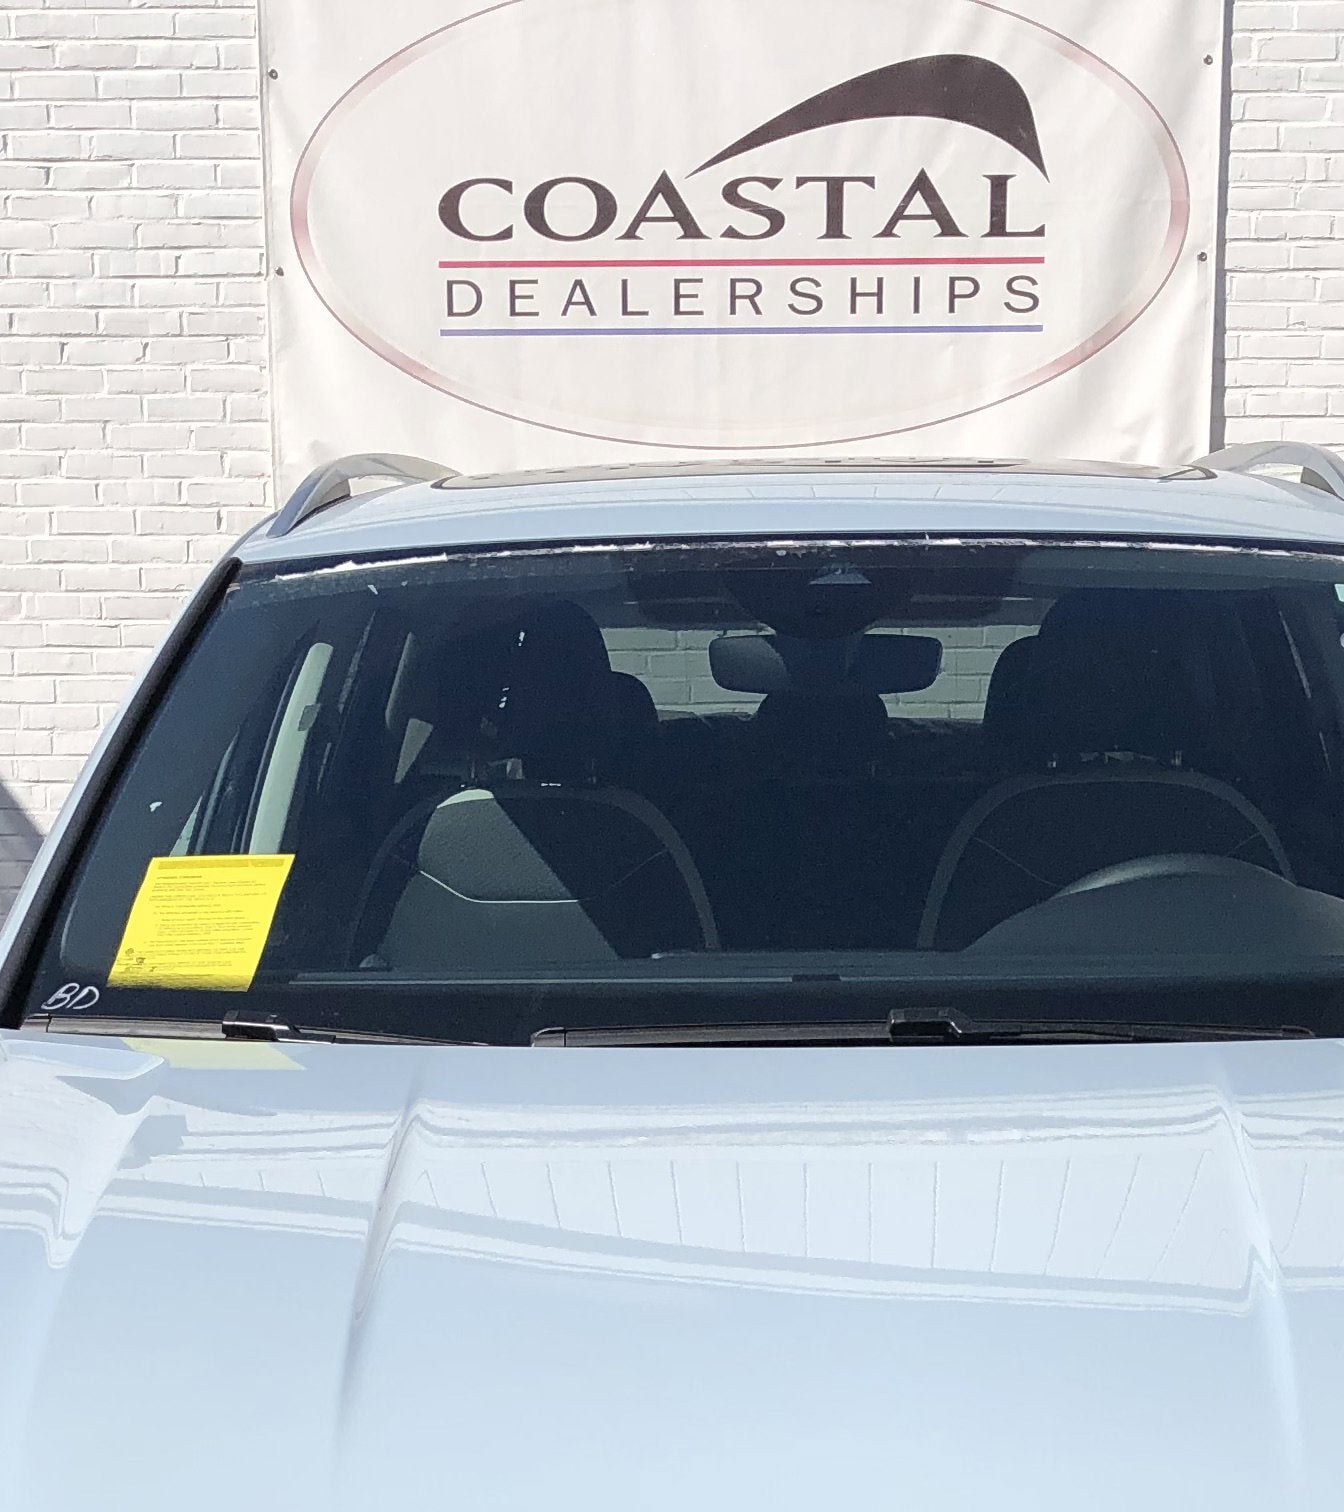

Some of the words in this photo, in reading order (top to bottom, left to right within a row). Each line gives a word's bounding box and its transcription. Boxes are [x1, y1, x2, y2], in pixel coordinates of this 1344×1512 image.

[437, 167, 1046, 242] COASTAL
[445, 274, 1040, 317] DEALERSHIPS
[41, 982, 99, 1010] BD
